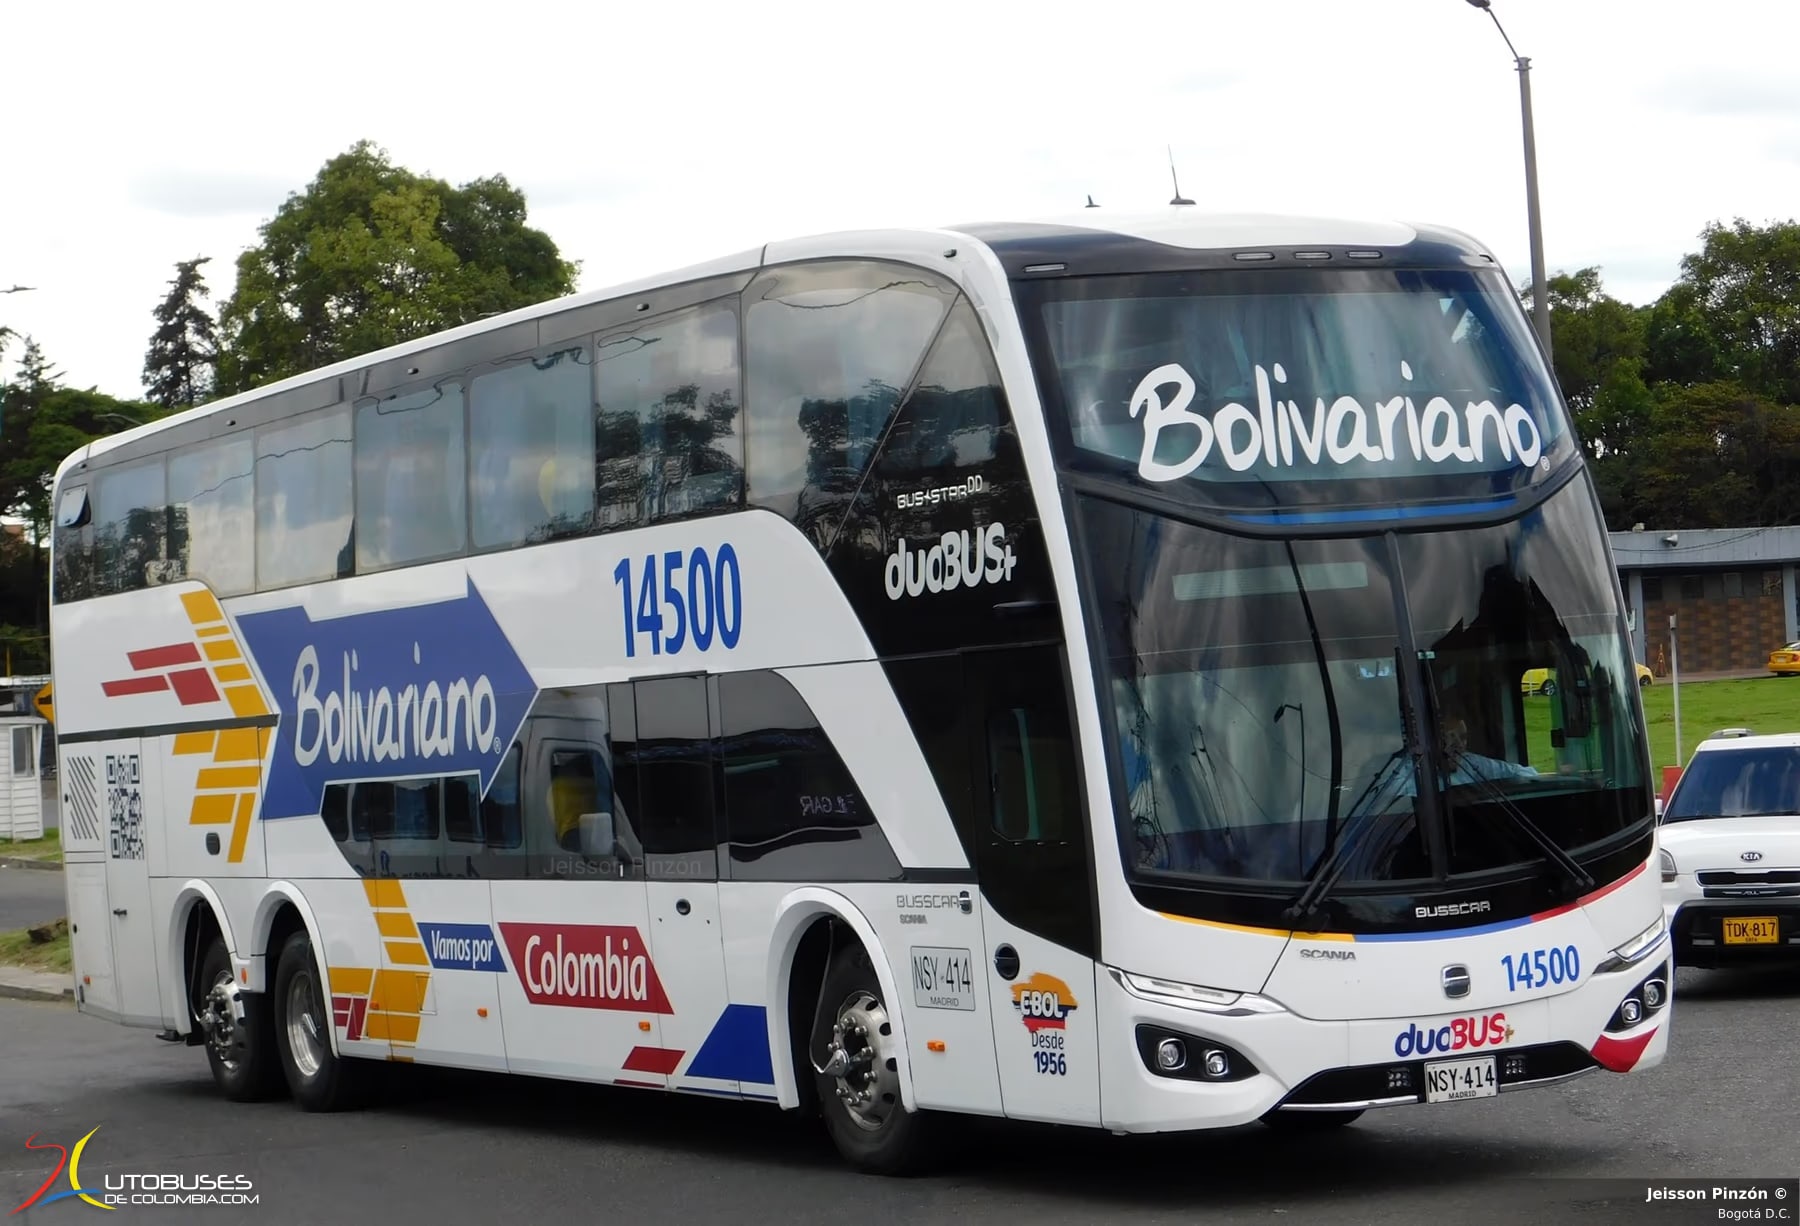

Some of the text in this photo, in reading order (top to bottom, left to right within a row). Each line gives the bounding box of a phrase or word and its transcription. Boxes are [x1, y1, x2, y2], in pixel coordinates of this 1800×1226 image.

[1129, 360, 1541, 482] Bolivariano
[613, 543, 742, 658] 14500
[292, 641, 497, 766] Bolivariano
[1742, 853, 1761, 861] KIA
[897, 895, 960, 909] BUSSCAR
[1415, 901, 1491, 919] BUSSCAR
[431, 930, 494, 969] Vamos por
[1300, 949, 1357, 961] SCANIA
[525, 934, 648, 1001] Colombia
[1501, 945, 1580, 992] 14500
[930, 997, 960, 1007] MADRID
[1031, 1031, 1065, 1050] Desde
[1033, 1051, 1067, 1077] 1956
[1448, 1091, 1477, 1099] MADRID
